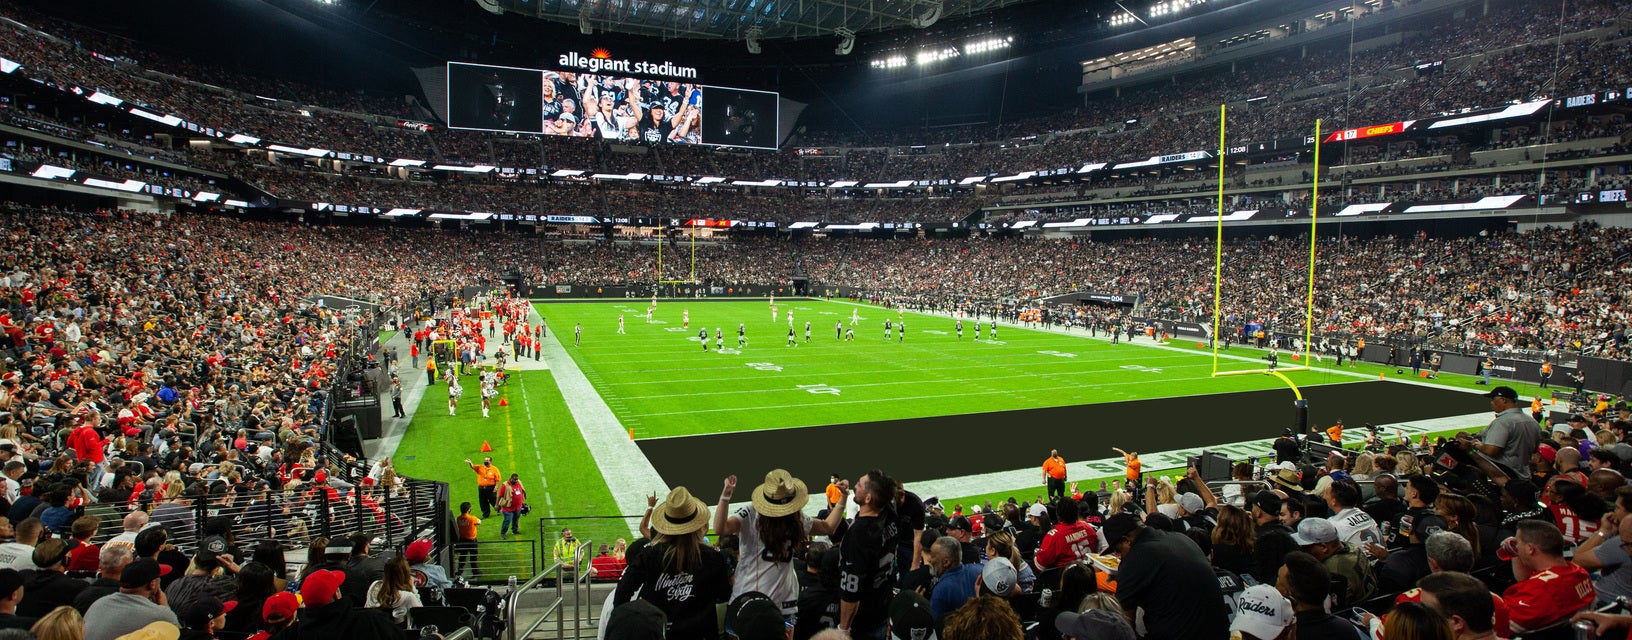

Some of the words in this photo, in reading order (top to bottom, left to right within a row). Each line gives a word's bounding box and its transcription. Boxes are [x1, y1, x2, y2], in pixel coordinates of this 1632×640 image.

[559, 51, 630, 72] allegiant
[634, 61, 697, 78] stadium
[1566, 94, 1596, 108] RAIDERS
[1366, 125, 1394, 136] CHIEFS
[1161, 154, 1186, 162] RAIDERS
[654, 571, 694, 592] Nineteen
[840, 570, 860, 593] 28
[667, 584, 695, 602] Sixty
[1239, 597, 1276, 617] Raiders
